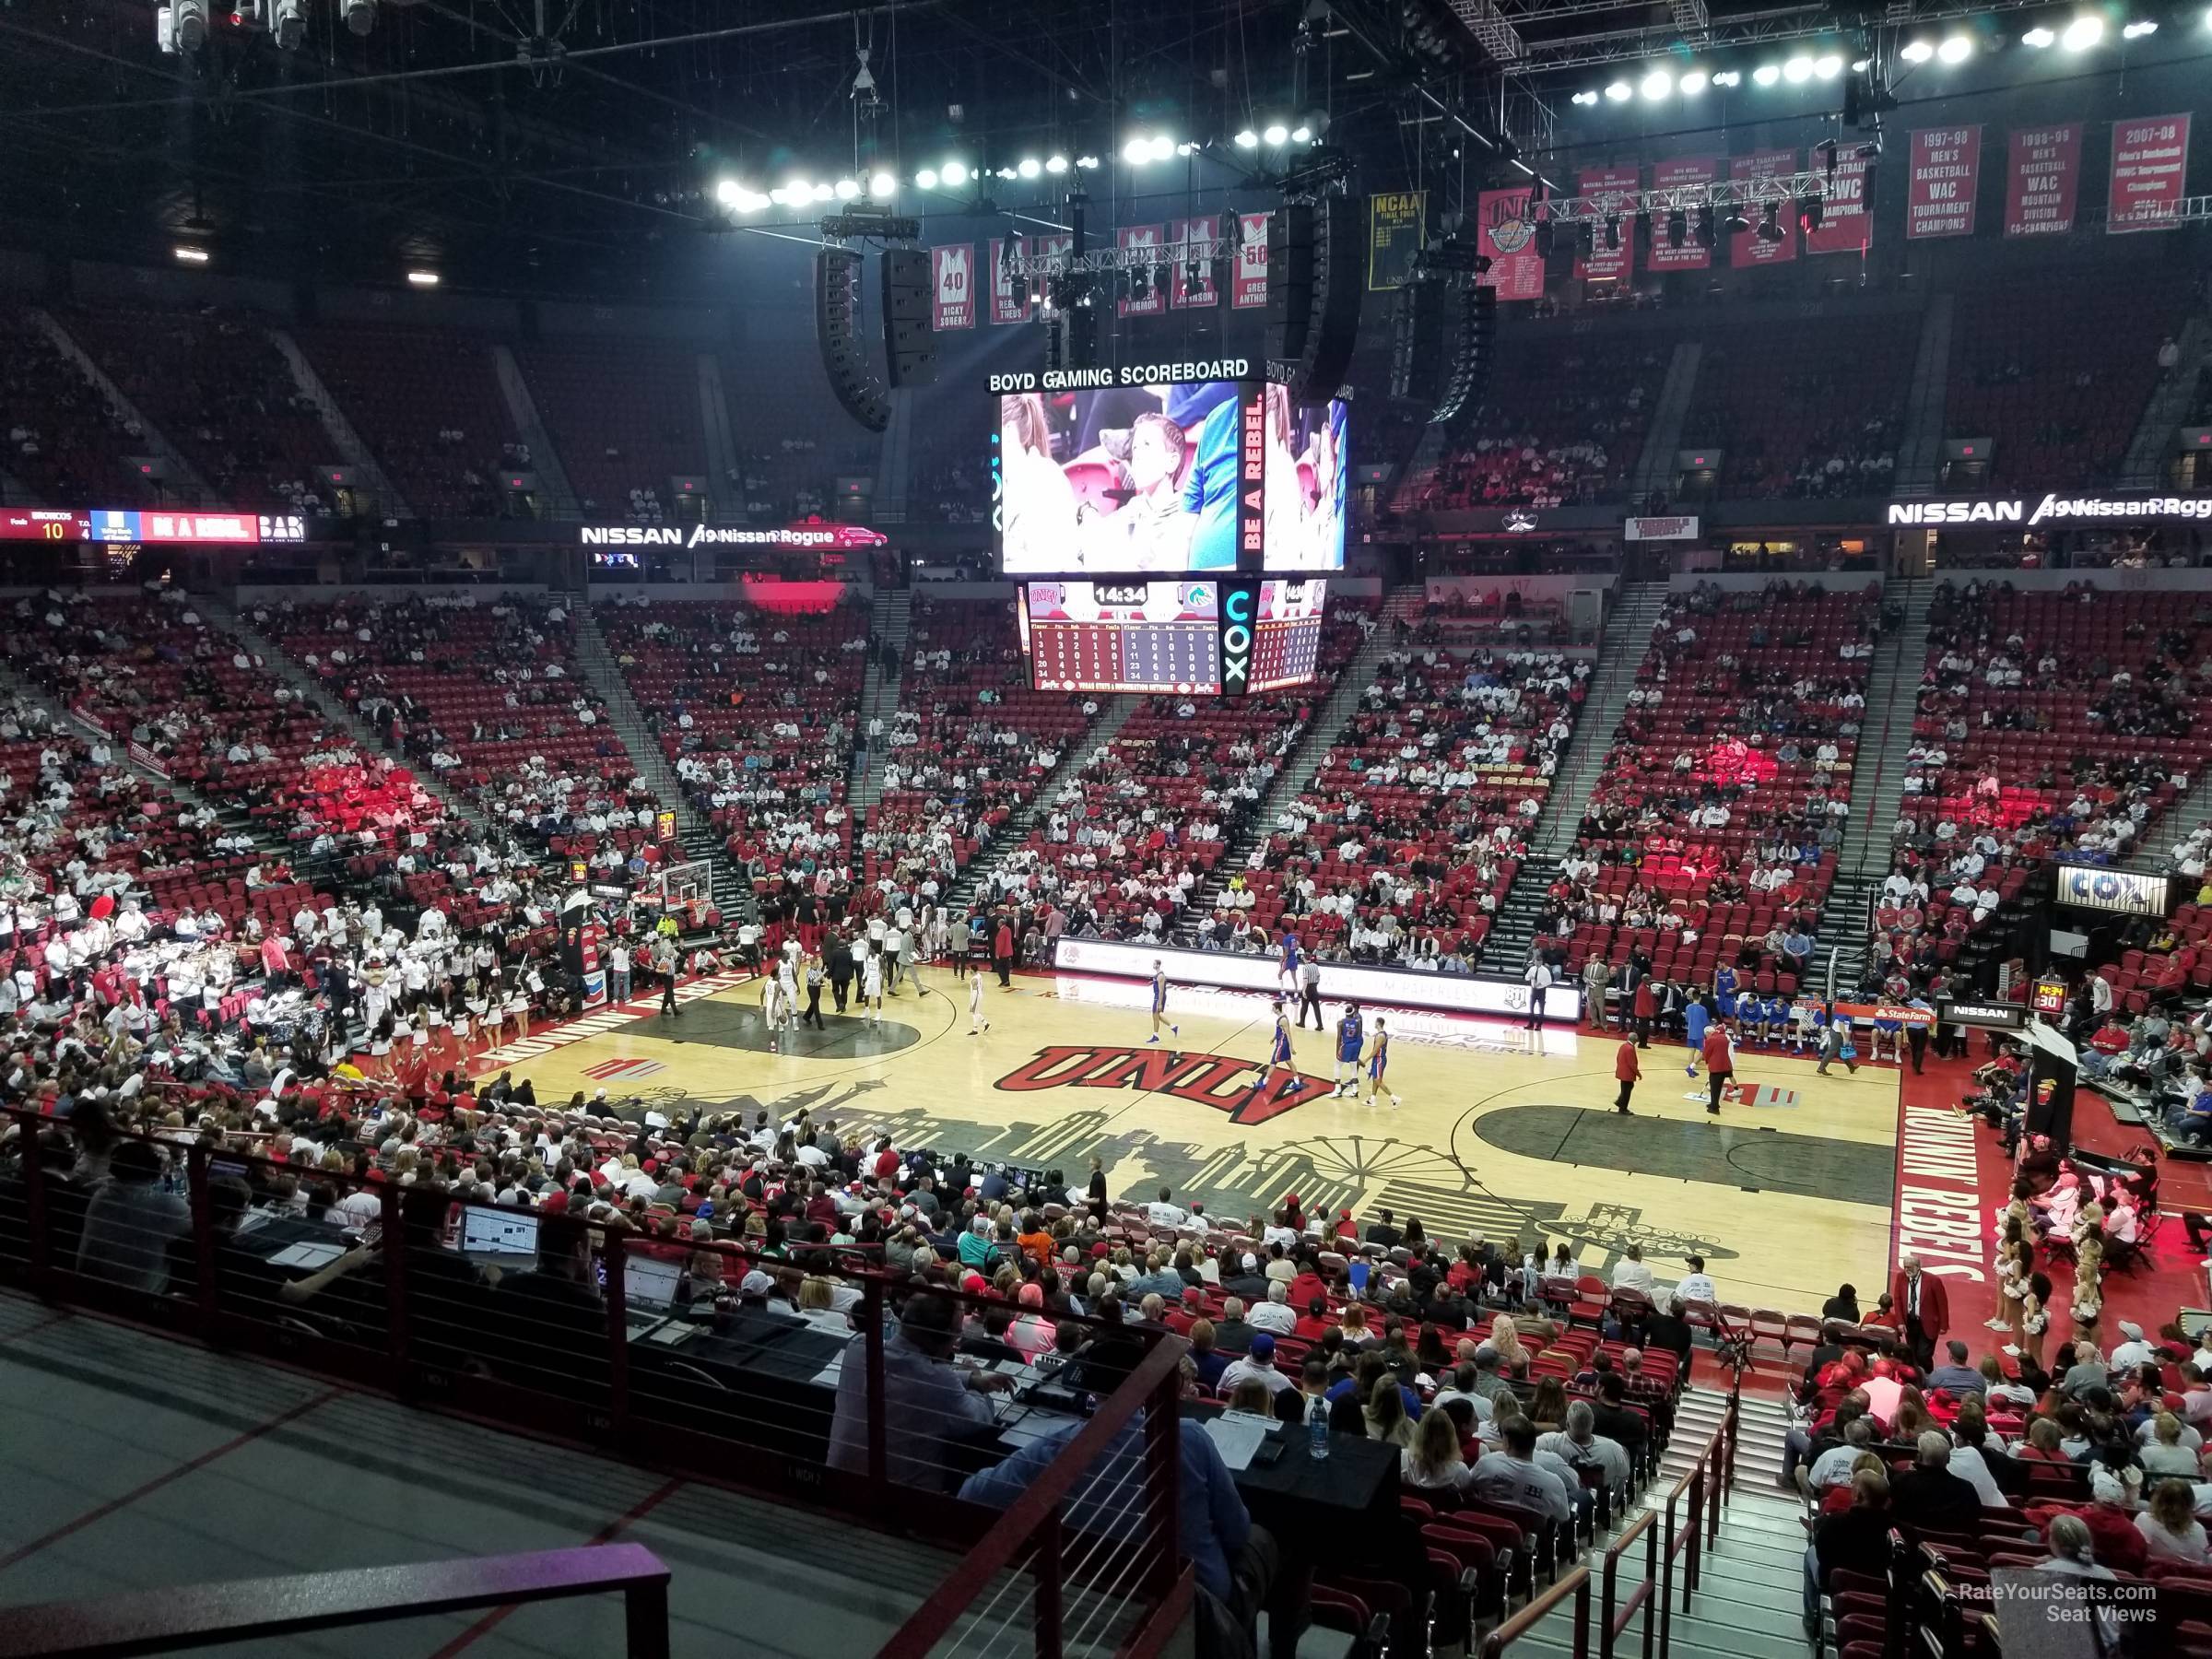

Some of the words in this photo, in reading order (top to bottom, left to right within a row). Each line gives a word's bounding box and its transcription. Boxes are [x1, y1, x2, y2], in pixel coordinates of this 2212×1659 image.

[1924, 132, 1968, 147] 1997-98
[2022, 130, 2069, 146] 1998-99
[2126, 125, 2175, 144] 2007-08
[1836, 149, 1855, 162] EN'S
[1931, 149, 1959, 162] MEN'S
[2032, 147, 2056, 159] MEN'S
[1916, 165, 1971, 181] BASKETBALL
[2020, 161, 2065, 174] BASKETBALL
[1929, 182, 1956, 199] WAC
[2028, 176, 2057, 192] WAC
[1376, 195, 1421, 212] NCAA
[2022, 193, 2062, 206] MOUNTAIN
[1913, 202, 1971, 218] TOURNAMENT
[2024, 207, 2057, 219] DIVISION
[1916, 218, 1965, 233] CHAMPIONS
[2011, 219, 2068, 234] CO-CHAMPIONS
[943, 272, 963, 290] 40
[1247, 283, 1266, 292] GREG
[943, 306, 963, 315] RICKY
[1125, 300, 1158, 312] AUGMON
[940, 316, 967, 326] SOBERS
[1000, 309, 1022, 319] THEUS
[990, 373, 1035, 392] BOYD
[1042, 368, 1113, 388] GAMING
[1121, 359, 1249, 385] SCOREBOARD
[1266, 359, 1285, 380] BOYD
[1245, 394, 1263, 479] REBEL.
[1245, 488, 1262, 511] A
[31, 512, 72, 521] BRONCOS
[1888, 501, 2022, 524] NISSAN
[2074, 499, 2156, 517] Nissan
[42, 523, 64, 539] 10
[81, 529, 90, 540] 4
[178, 517, 192, 537] A
[1244, 519, 1261, 549] BE
[582, 527, 682, 545] NISSAN
[721, 529, 777, 543] Nissan
[781, 530, 834, 546] Rogue
[1030, 589, 1057, 605] UNLV
[1096, 587, 1147, 602] 14:34
[1187, 633, 1194, 641] 0
[1224, 591, 1250, 682] COX
[1094, 652, 1099, 660] 1
[1189, 653, 1194, 662] 0
[1059, 661, 1065, 669] 4
[1094, 662, 1100, 670] 0
[1060, 671, 1065, 679] 0
[1153, 673, 1159, 681] 0
[1209, 674, 1216, 682] 0
[660, 822, 673, 838] 30
[595, 885, 623, 895] NISSAN
[2071, 872, 2144, 901] COX
[627, 971, 752, 1010] REBELS
[2039, 984, 2064, 996] 14:34
[2040, 994, 2056, 1008] 30
[1358, 1004, 1445, 1019] CENTER
[1954, 1006, 2008, 1018] NISSAN
[993, 1045, 1342, 1125] UNLV
[1899, 1184, 1985, 1282] REBELS
[1567, 1228, 1617, 1241] LAS
[1625, 1236, 1713, 1257] VEGAS
